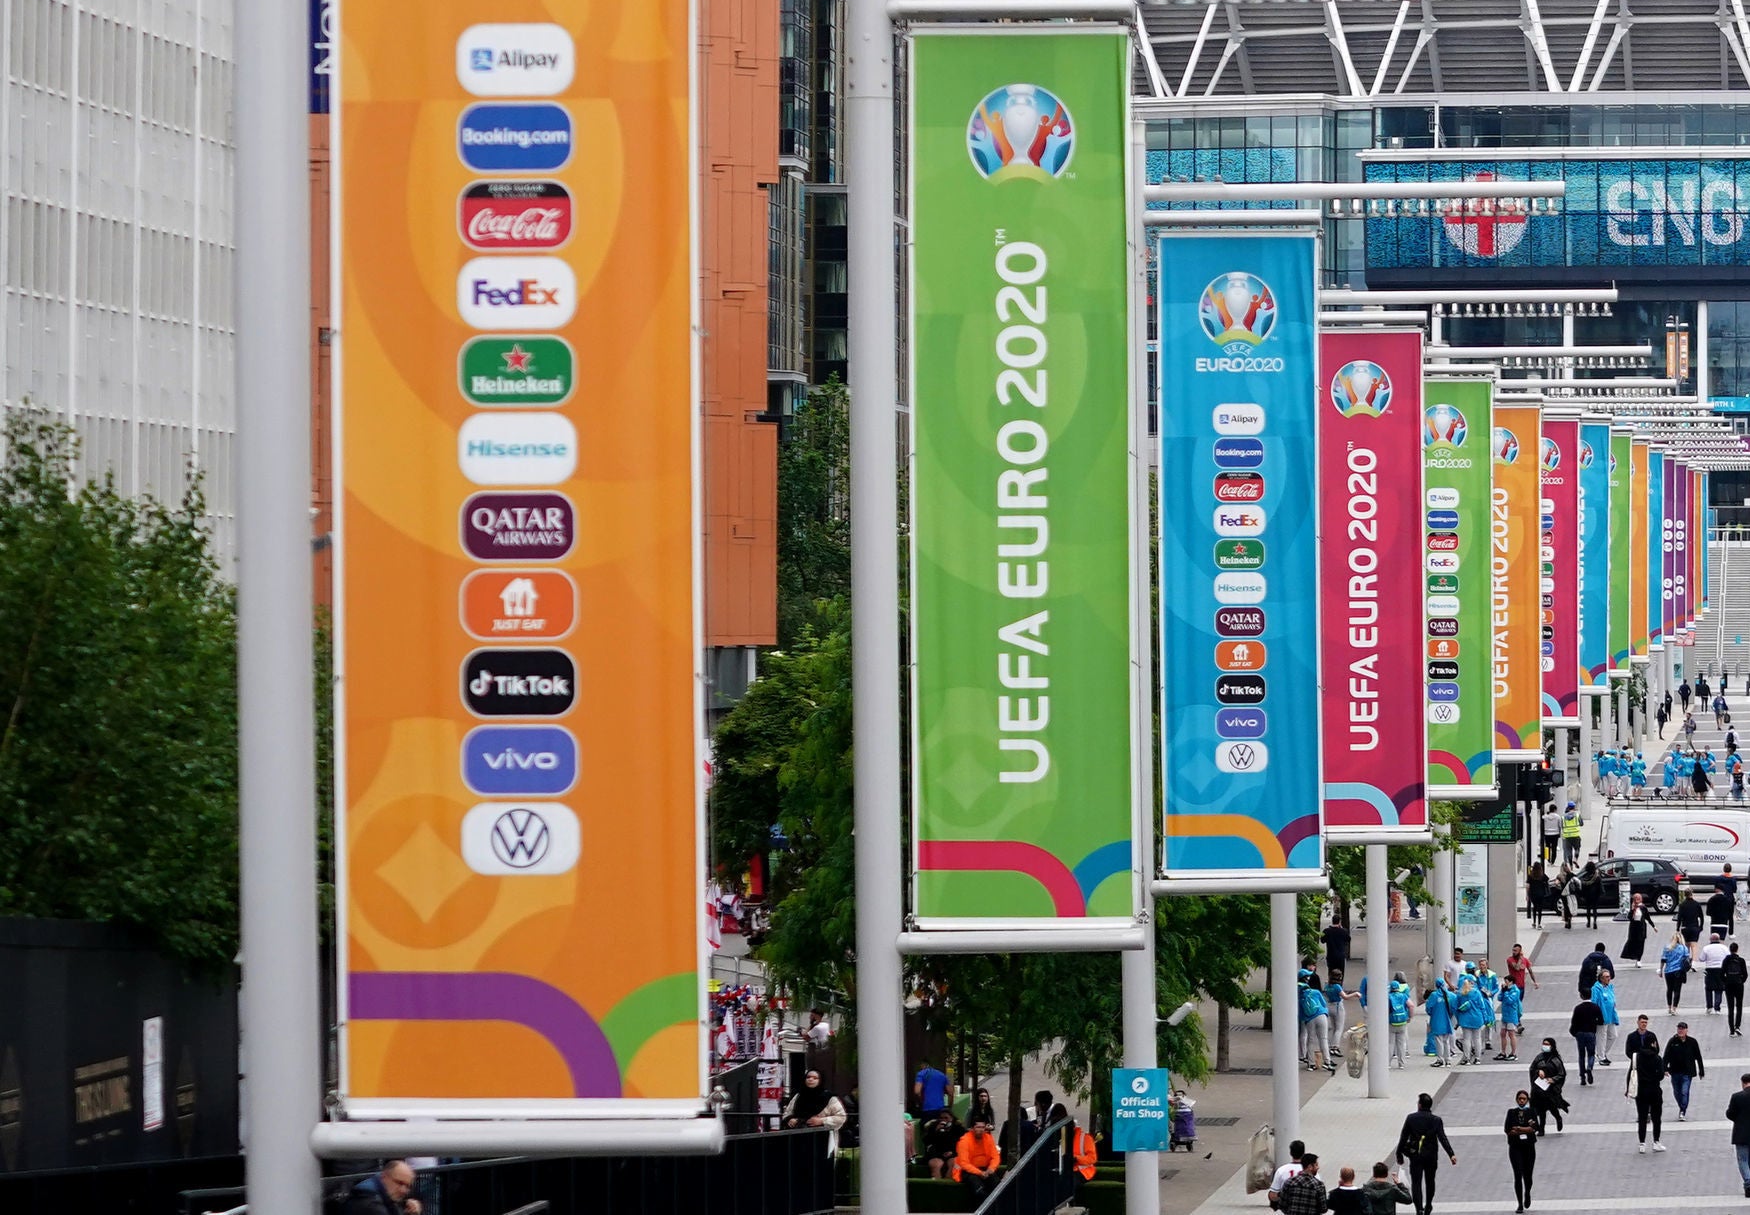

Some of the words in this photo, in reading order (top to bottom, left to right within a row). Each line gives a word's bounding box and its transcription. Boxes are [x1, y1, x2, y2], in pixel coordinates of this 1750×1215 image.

[498, 50, 558, 70] Alipay
[463, 128, 568, 148] Booking.com
[473, 280, 559, 305] FedEx
[1225, 344, 1251, 355] UEFA
[472, 376, 562, 394] Heineken
[1230, 415, 1258, 425] Alipay
[468, 440, 568, 456] Hisense
[1215, 448, 1262, 458] Booking.com
[1424, 459, 1472, 468] URO2020
[997, 421, 1049, 599] EURO
[470, 507, 565, 534] QATAR
[1220, 515, 1258, 527] FedEx
[493, 531, 566, 545] AIRWAYS
[1220, 556, 1260, 565] Heineken
[1430, 559, 1455, 567] FedEx
[1217, 584, 1263, 593] Hisense
[1348, 548, 1378, 648] EURO
[492, 619, 517, 631] JUST
[521, 619, 546, 631] EAT
[1219, 613, 1260, 625] QATAR
[1430, 621, 1456, 630] QATAR
[494, 675, 569, 696] TikTok
[1230, 686, 1263, 695] TikTok
[998, 611, 1050, 784] UEFA
[1349, 654, 1379, 751] UEFA
[1225, 717, 1258, 727] vivo
[483, 749, 560, 769] vivo
[1121, 1097, 1160, 1106] Official
[1116, 1109, 1135, 1118] Fan
[1138, 1109, 1164, 1120] Shop
